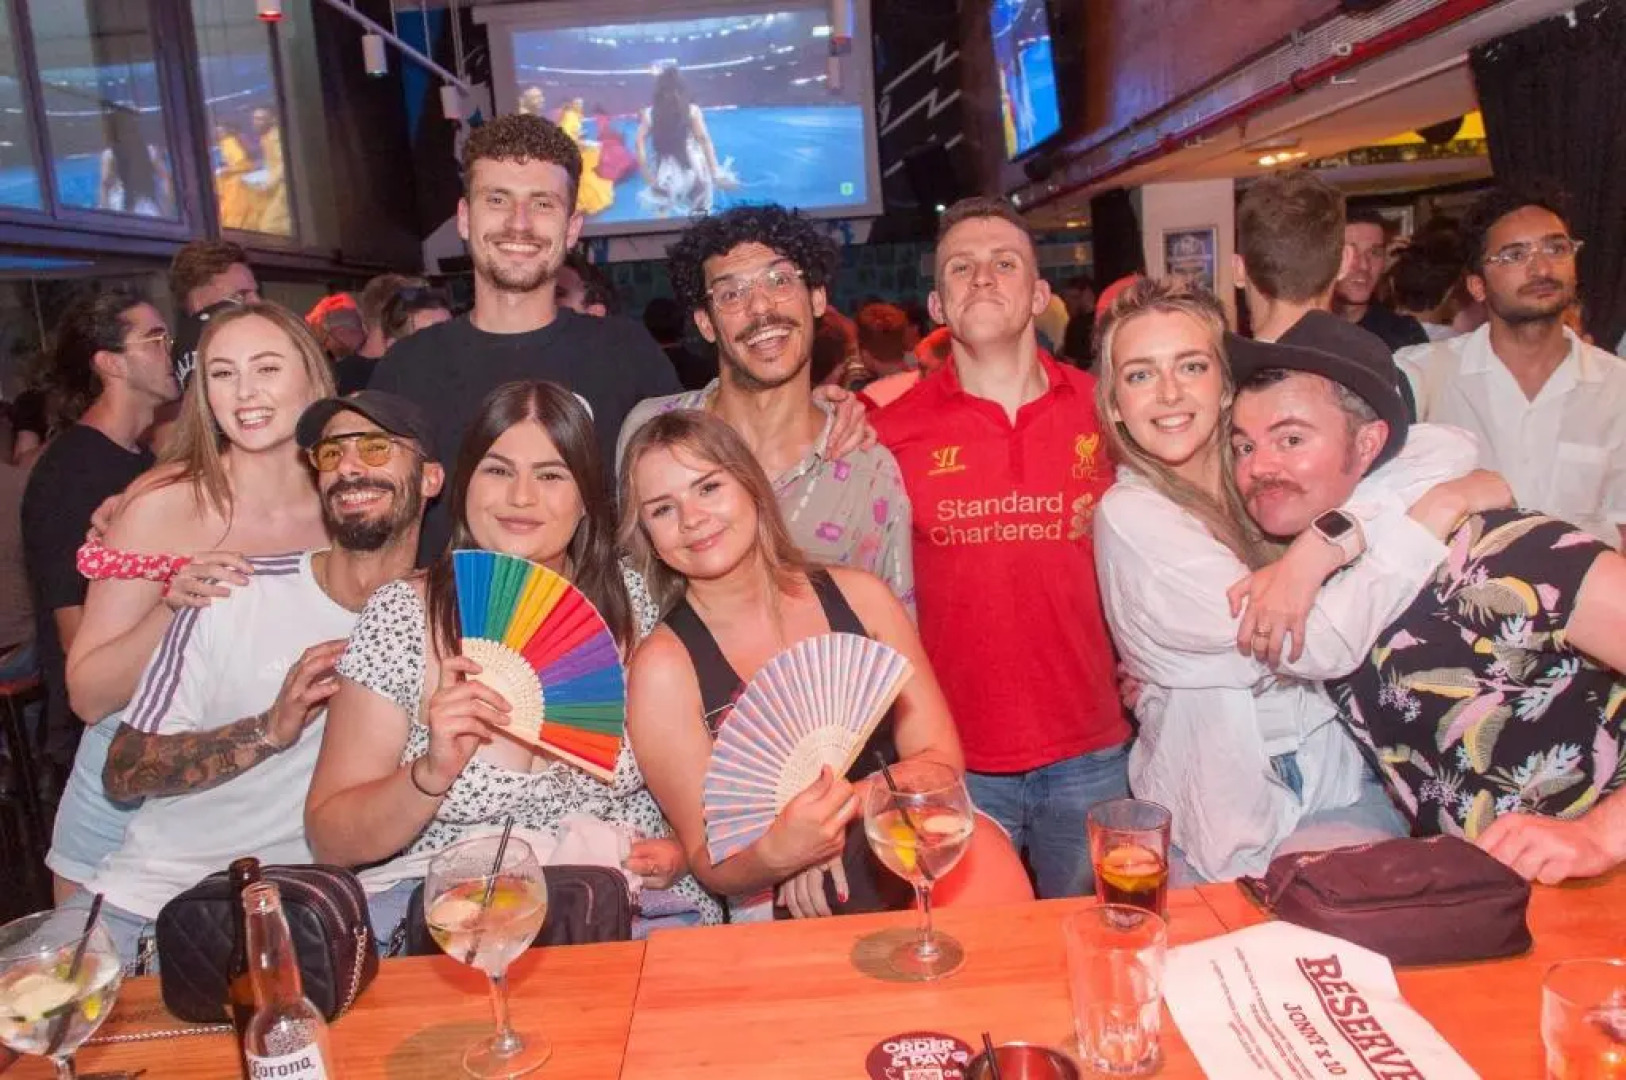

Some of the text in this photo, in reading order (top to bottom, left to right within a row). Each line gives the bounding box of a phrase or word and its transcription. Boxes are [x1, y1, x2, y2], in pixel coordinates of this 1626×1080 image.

[936, 491, 1063, 521] Standard
[930, 519, 1062, 546] Chartered
[882, 1038, 955, 1053] ORDER
[1282, 1002, 1328, 1046] JONNY
[1323, 1060, 1347, 1076] 10
[249, 1056, 314, 1078] Corona
[892, 1054, 907, 1067] &
[910, 1052, 950, 1066] PAY
